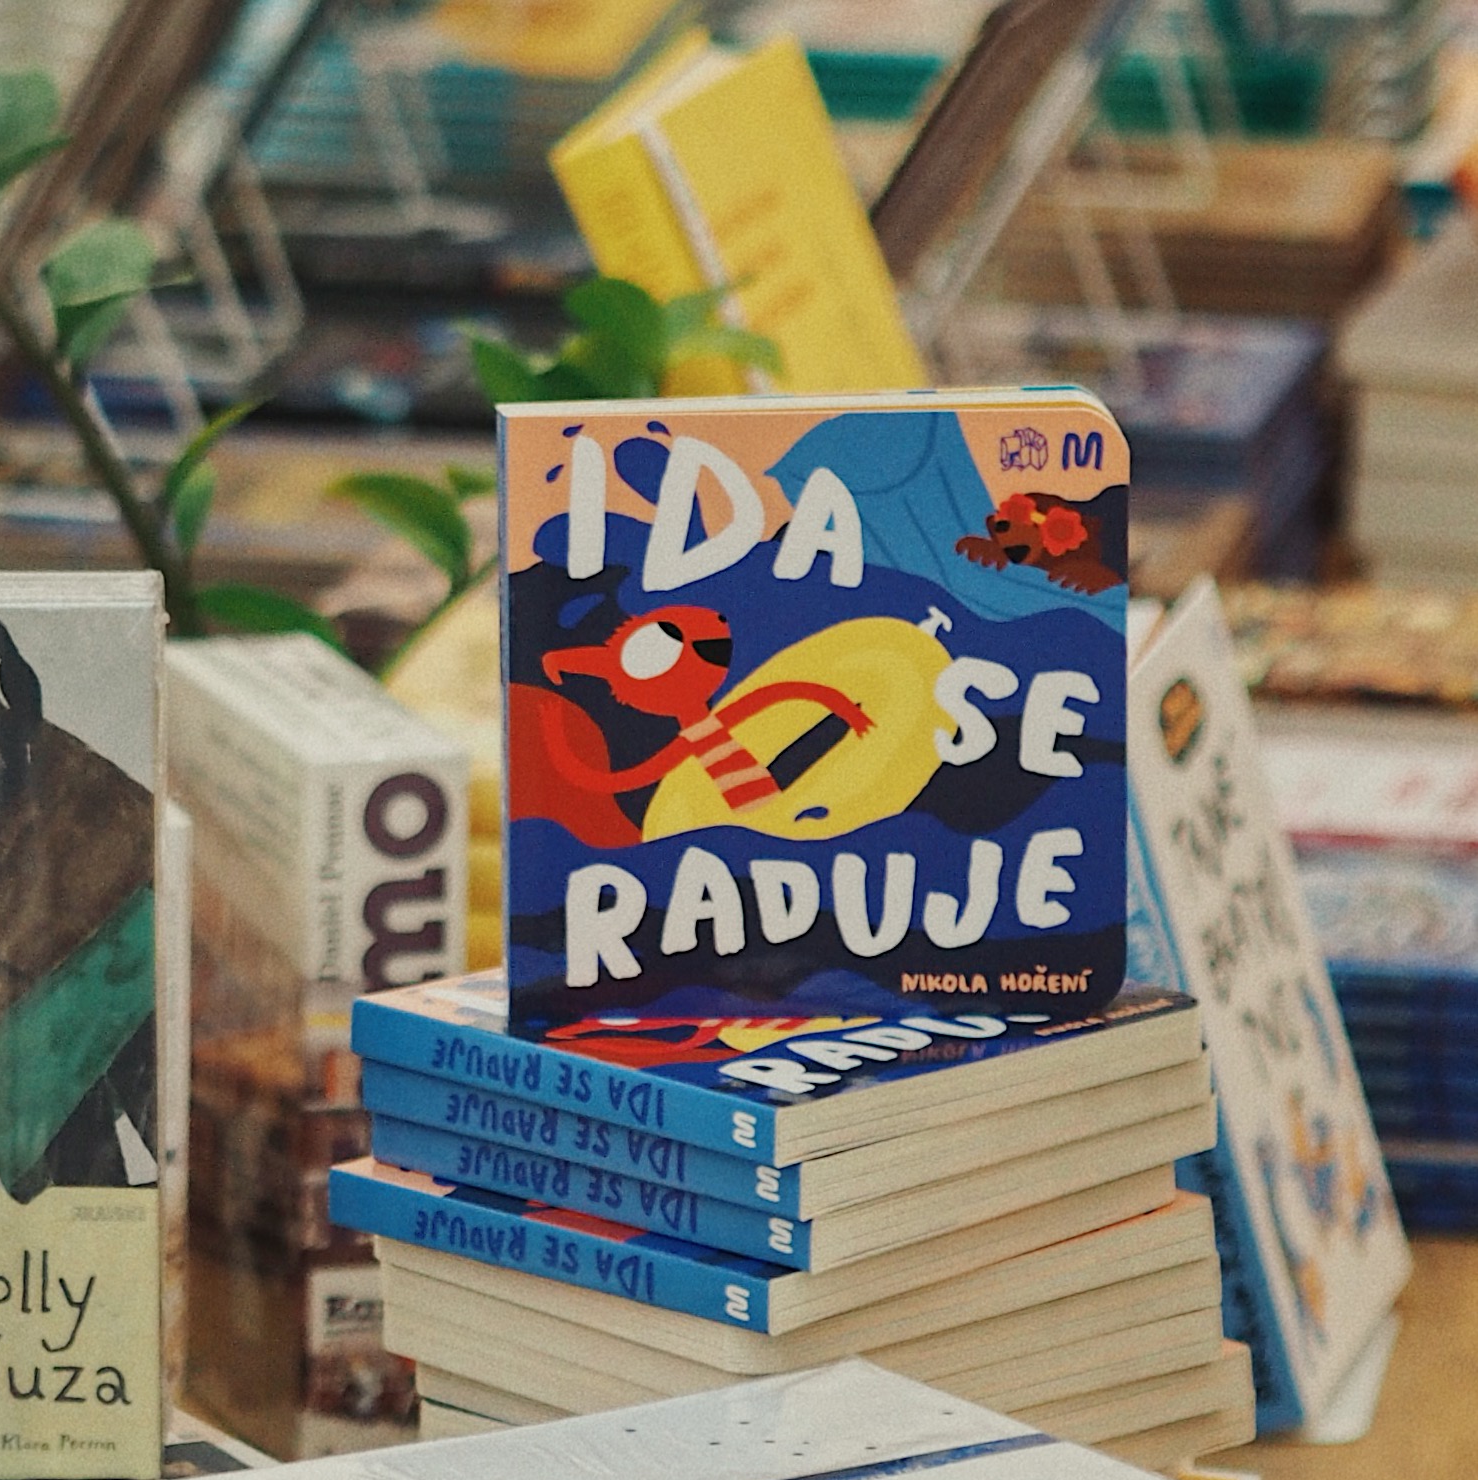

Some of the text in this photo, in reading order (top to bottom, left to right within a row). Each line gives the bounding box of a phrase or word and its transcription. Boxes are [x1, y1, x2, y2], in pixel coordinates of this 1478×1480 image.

[567, 434, 864, 592] IDA
[934, 656, 1100, 778] SE
[565, 827, 1084, 988] RADUJE
[901, 964, 1094, 994] NIKOLA HOŘENÍ
[431, 1037, 665, 1128] IDA SE RADUJE
[445, 1093, 686, 1182] IDA SE RADUJE
[457, 1145, 699, 1234] IDA SE RADUJE
[414, 1210, 655, 1301] IDA SE RADUJE
